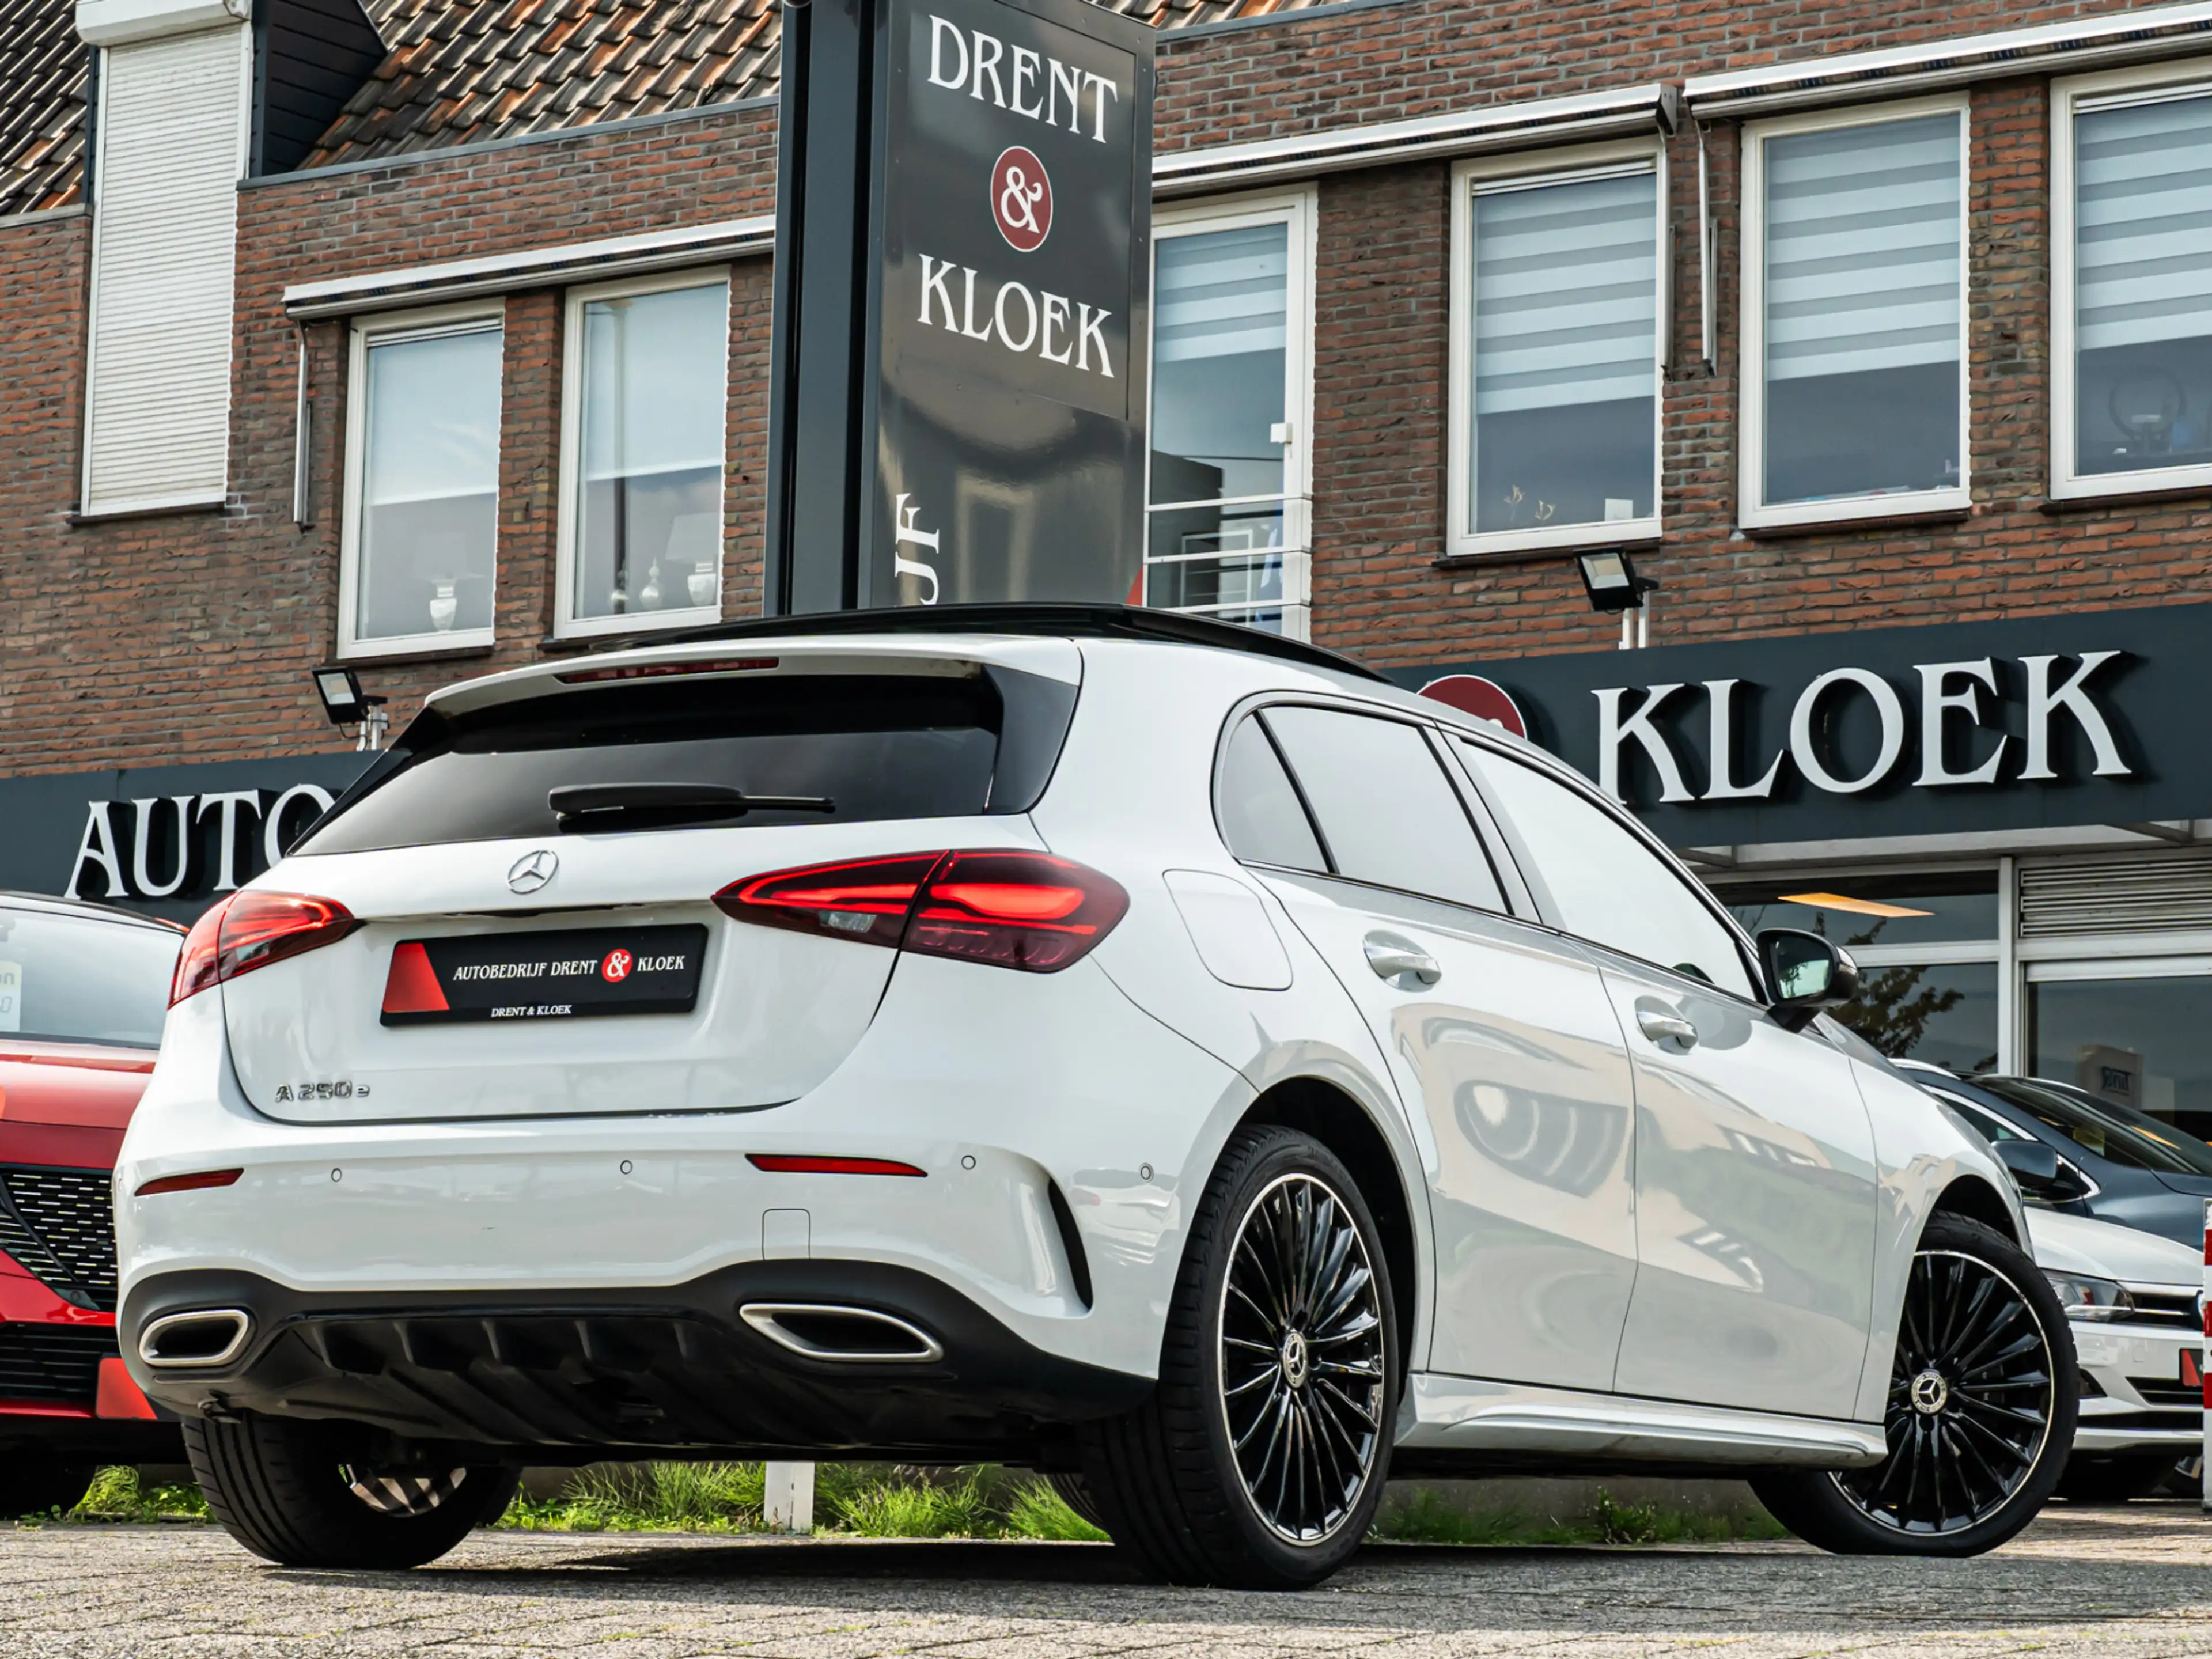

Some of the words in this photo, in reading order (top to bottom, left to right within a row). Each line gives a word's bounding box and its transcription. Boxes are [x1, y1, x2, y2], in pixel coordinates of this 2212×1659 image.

[927, 14, 1118, 143] DRENT
[1000, 166, 1043, 234] &
[917, 253, 1115, 378] KLOEK
[1591, 650, 2132, 805] KLOEK
[453, 963, 547, 980] AUTOBEDRIJF
[550, 960, 598, 976] DRENT
[607, 952, 630, 978] &
[637, 956, 685, 971] KLOEK
[491, 1006, 527, 1017] DRENT
[527, 1006, 535, 1016] &
[536, 1005, 572, 1015] KLOEK
